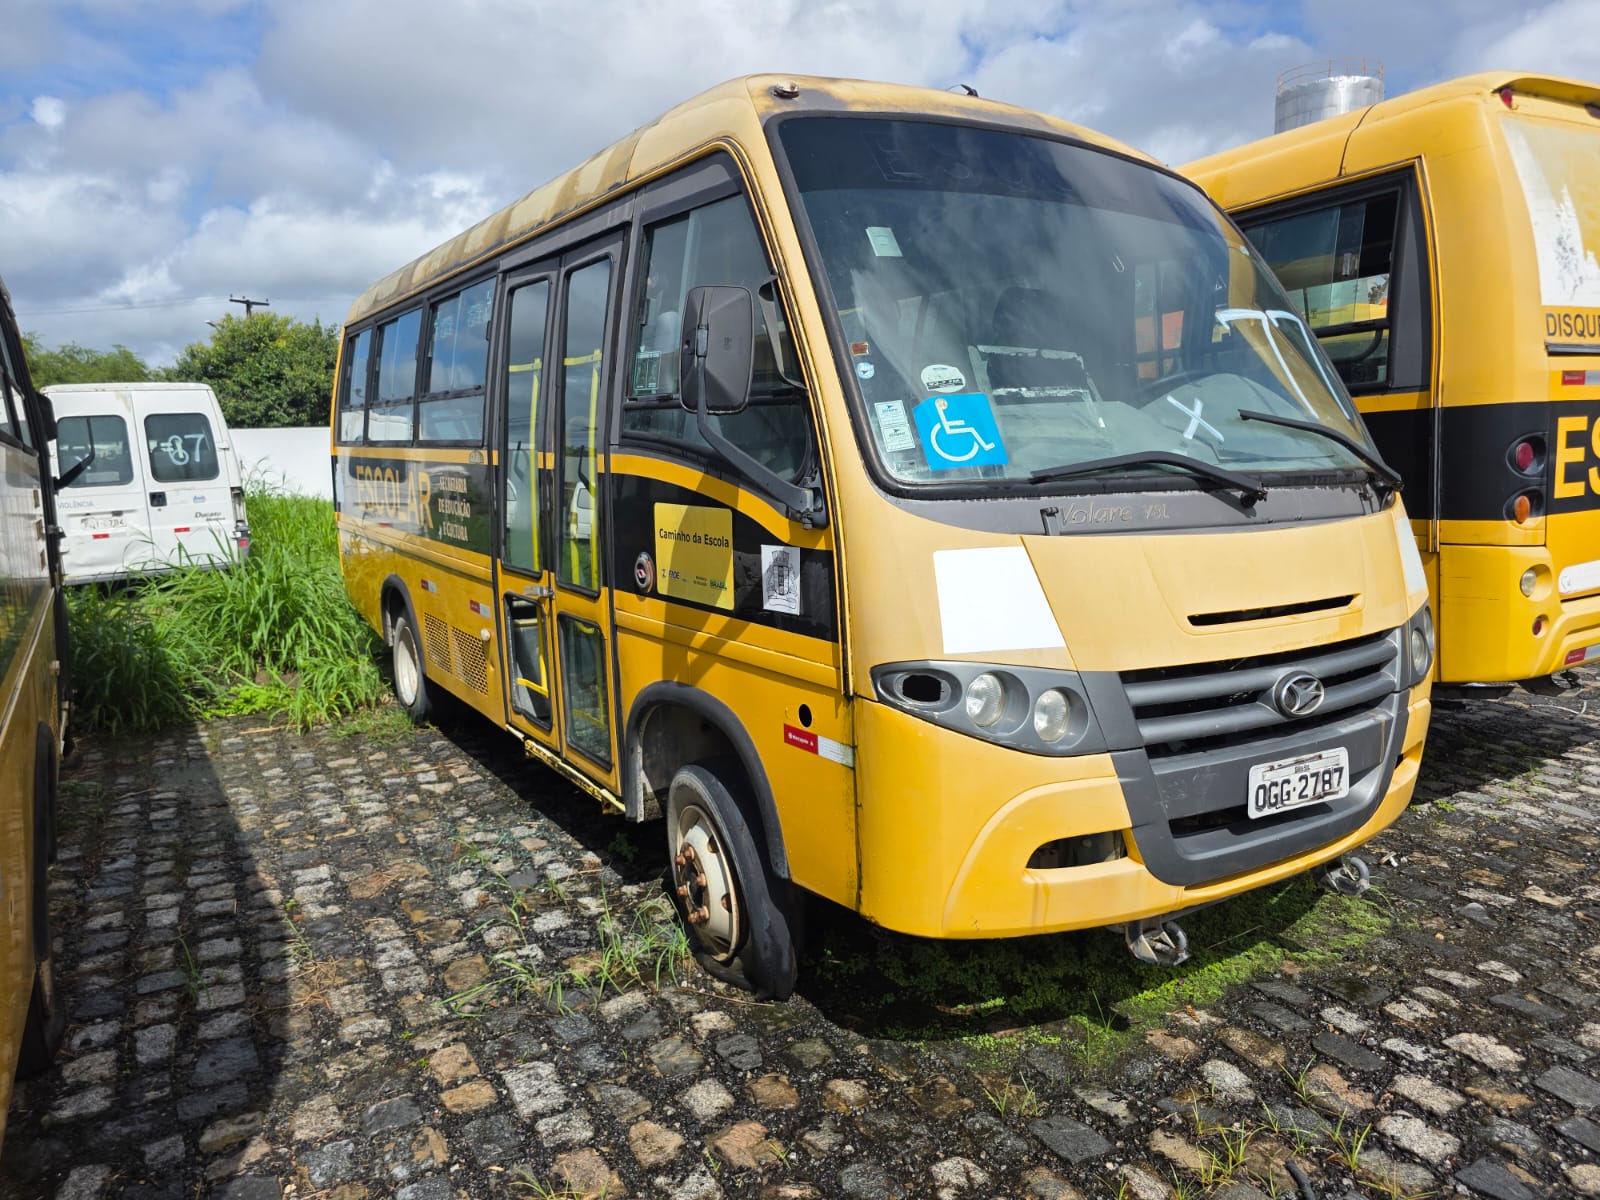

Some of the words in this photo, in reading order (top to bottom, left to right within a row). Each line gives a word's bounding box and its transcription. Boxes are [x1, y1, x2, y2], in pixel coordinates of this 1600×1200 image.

[439, 476, 468, 494] SECRETARIA
[57, 500, 94, 509] VIOLÊNCIA
[356, 465, 434, 529] ESCOLAR
[438, 498, 444, 513] DE
[445, 498, 471, 521] EDUCAÇÃO
[1060, 502, 1133, 526] Volare
[447, 522, 469, 542] CULTURA
[659, 528, 690, 543] Caminho
[692, 532, 702, 544] da
[704, 534, 730, 549] Escola
